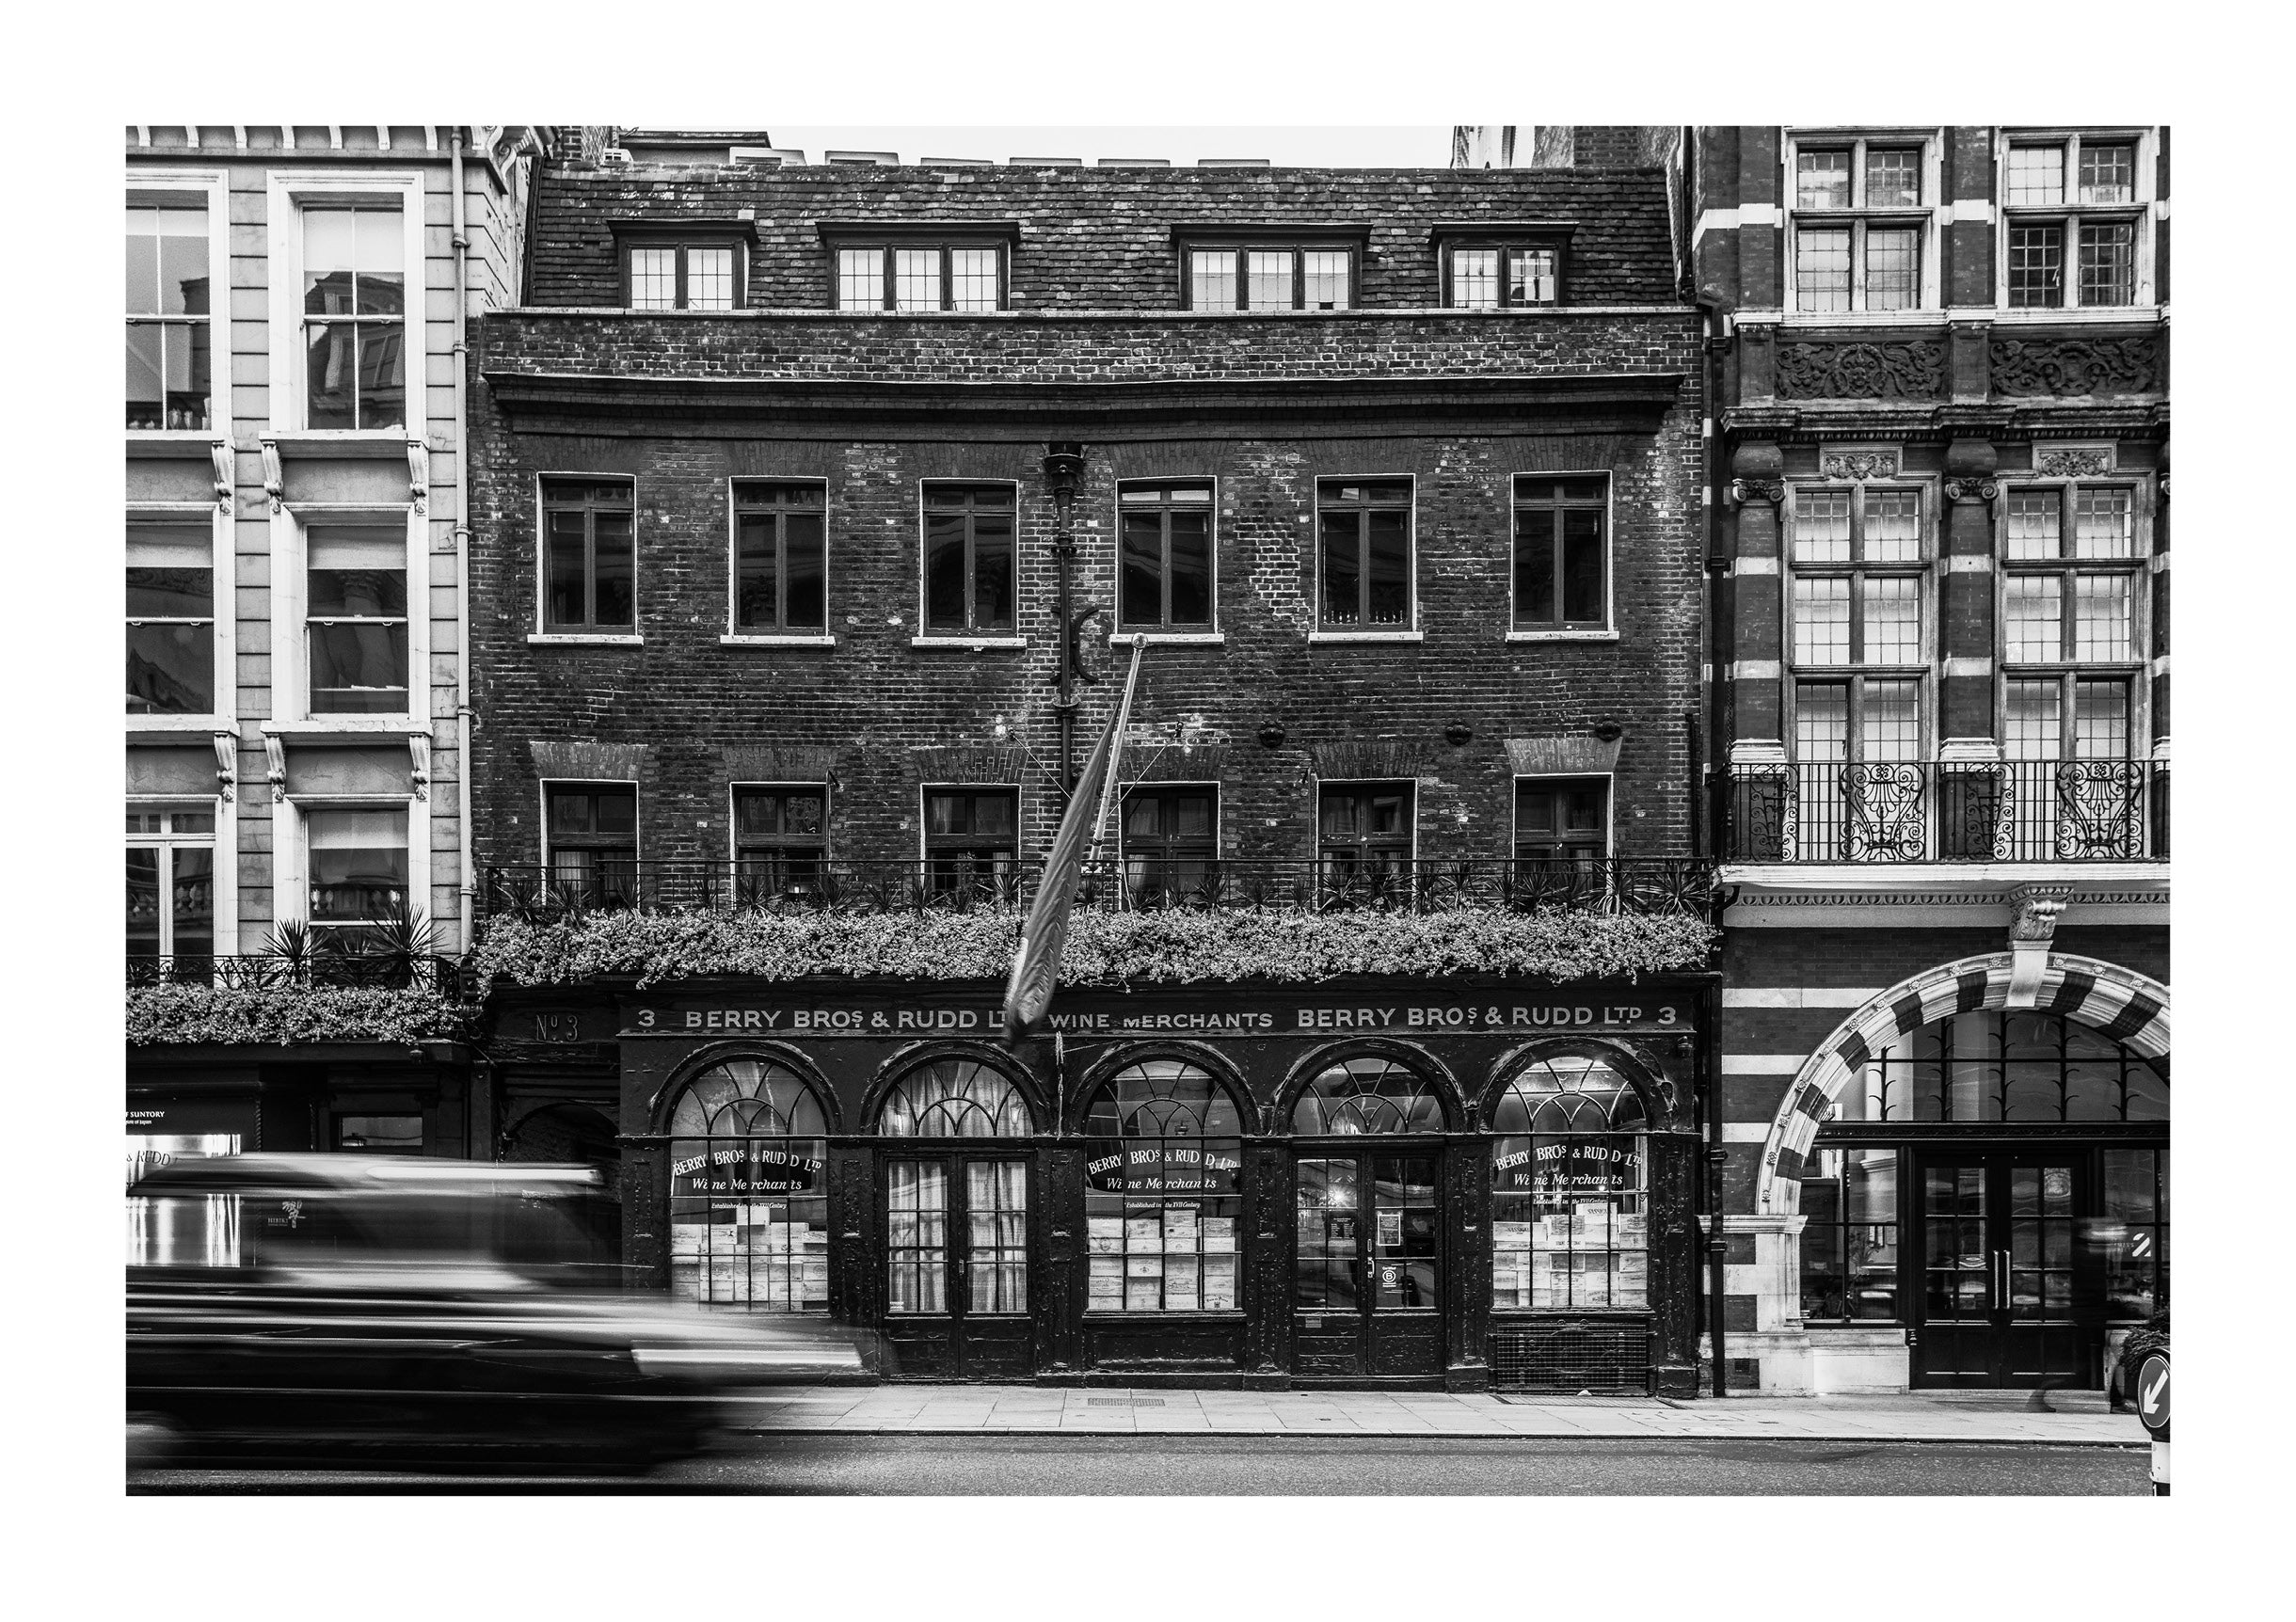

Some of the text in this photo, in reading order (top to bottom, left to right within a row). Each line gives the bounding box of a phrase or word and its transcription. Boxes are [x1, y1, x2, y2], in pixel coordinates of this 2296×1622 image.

[638, 1010, 655, 1027] 3
[686, 1010, 782, 1027] BERRY
[870, 1011, 890, 1027] &
[898, 1010, 978, 1027] RUDD
[988, 1010, 1006, 1027] LT
[1048, 1013, 1273, 1028] WINE MERCHANTS
[1298, 1009, 1396, 1027] BERRY
[1484, 1007, 1505, 1025] &
[1512, 1007, 1593, 1026] RUDD
[1657, 1007, 1677, 1025] 3
[566, 1015, 578, 1042] 3
[136, 1150, 171, 1166] RUDD
[673, 1154, 707, 1176] BERRY
[751, 1153, 759, 1163] &
[762, 1151, 800, 1168] RUDD
[1088, 1153, 1123, 1175] BERRY
[1165, 1153, 1172, 1162] &
[1175, 1149, 1216, 1167] RUDD
[1495, 1150, 1530, 1171] BERRY
[1572, 1149, 1581, 1158] &
[1584, 1145, 1621, 1163] RUDD
[693, 1178, 802, 1190] Wine Merchants
[1107, 1177, 1217, 1189] Wine Merchants
[1514, 1173, 1623, 1185] Wine Merchants
